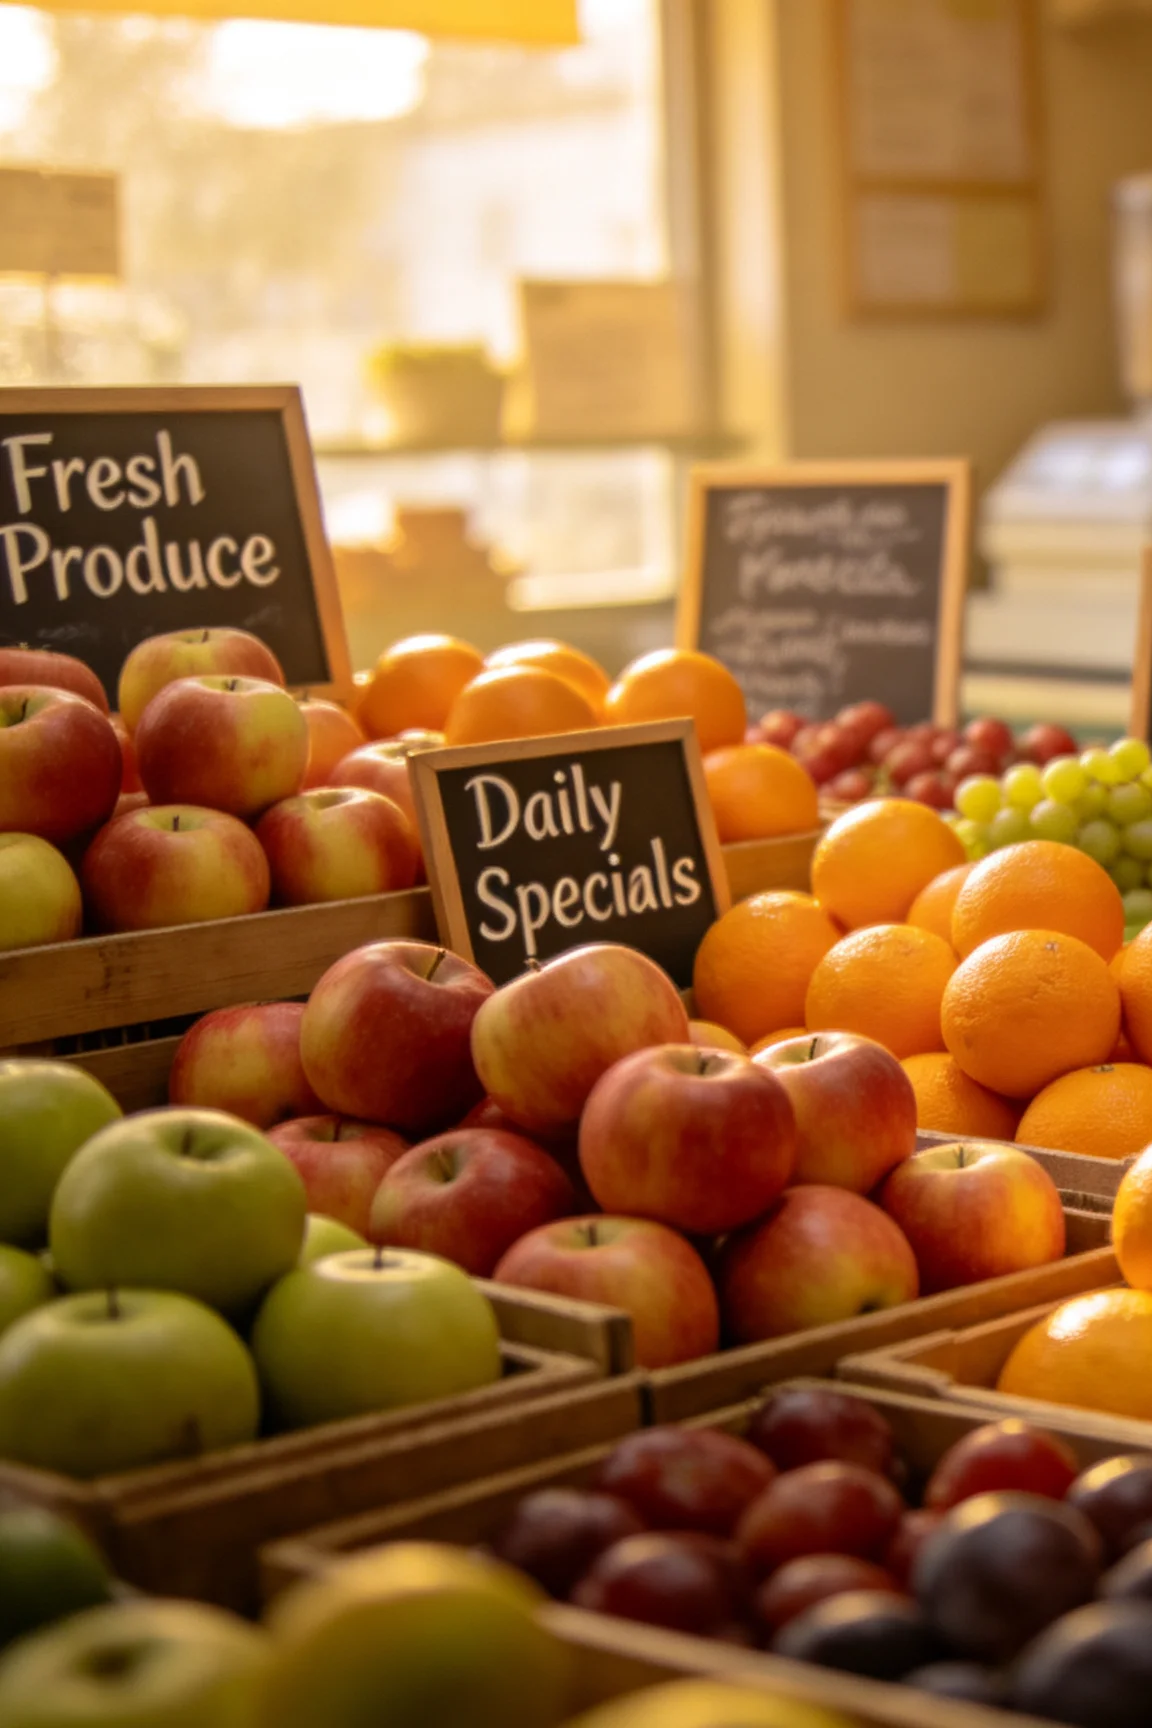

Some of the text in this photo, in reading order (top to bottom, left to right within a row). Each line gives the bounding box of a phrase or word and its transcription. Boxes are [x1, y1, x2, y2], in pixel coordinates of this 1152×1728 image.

[1, 429, 206, 514] Fresh
[0, 516, 281, 605] Produce
[464, 763, 622, 851] Daily
[476, 836, 701, 957] Specials
